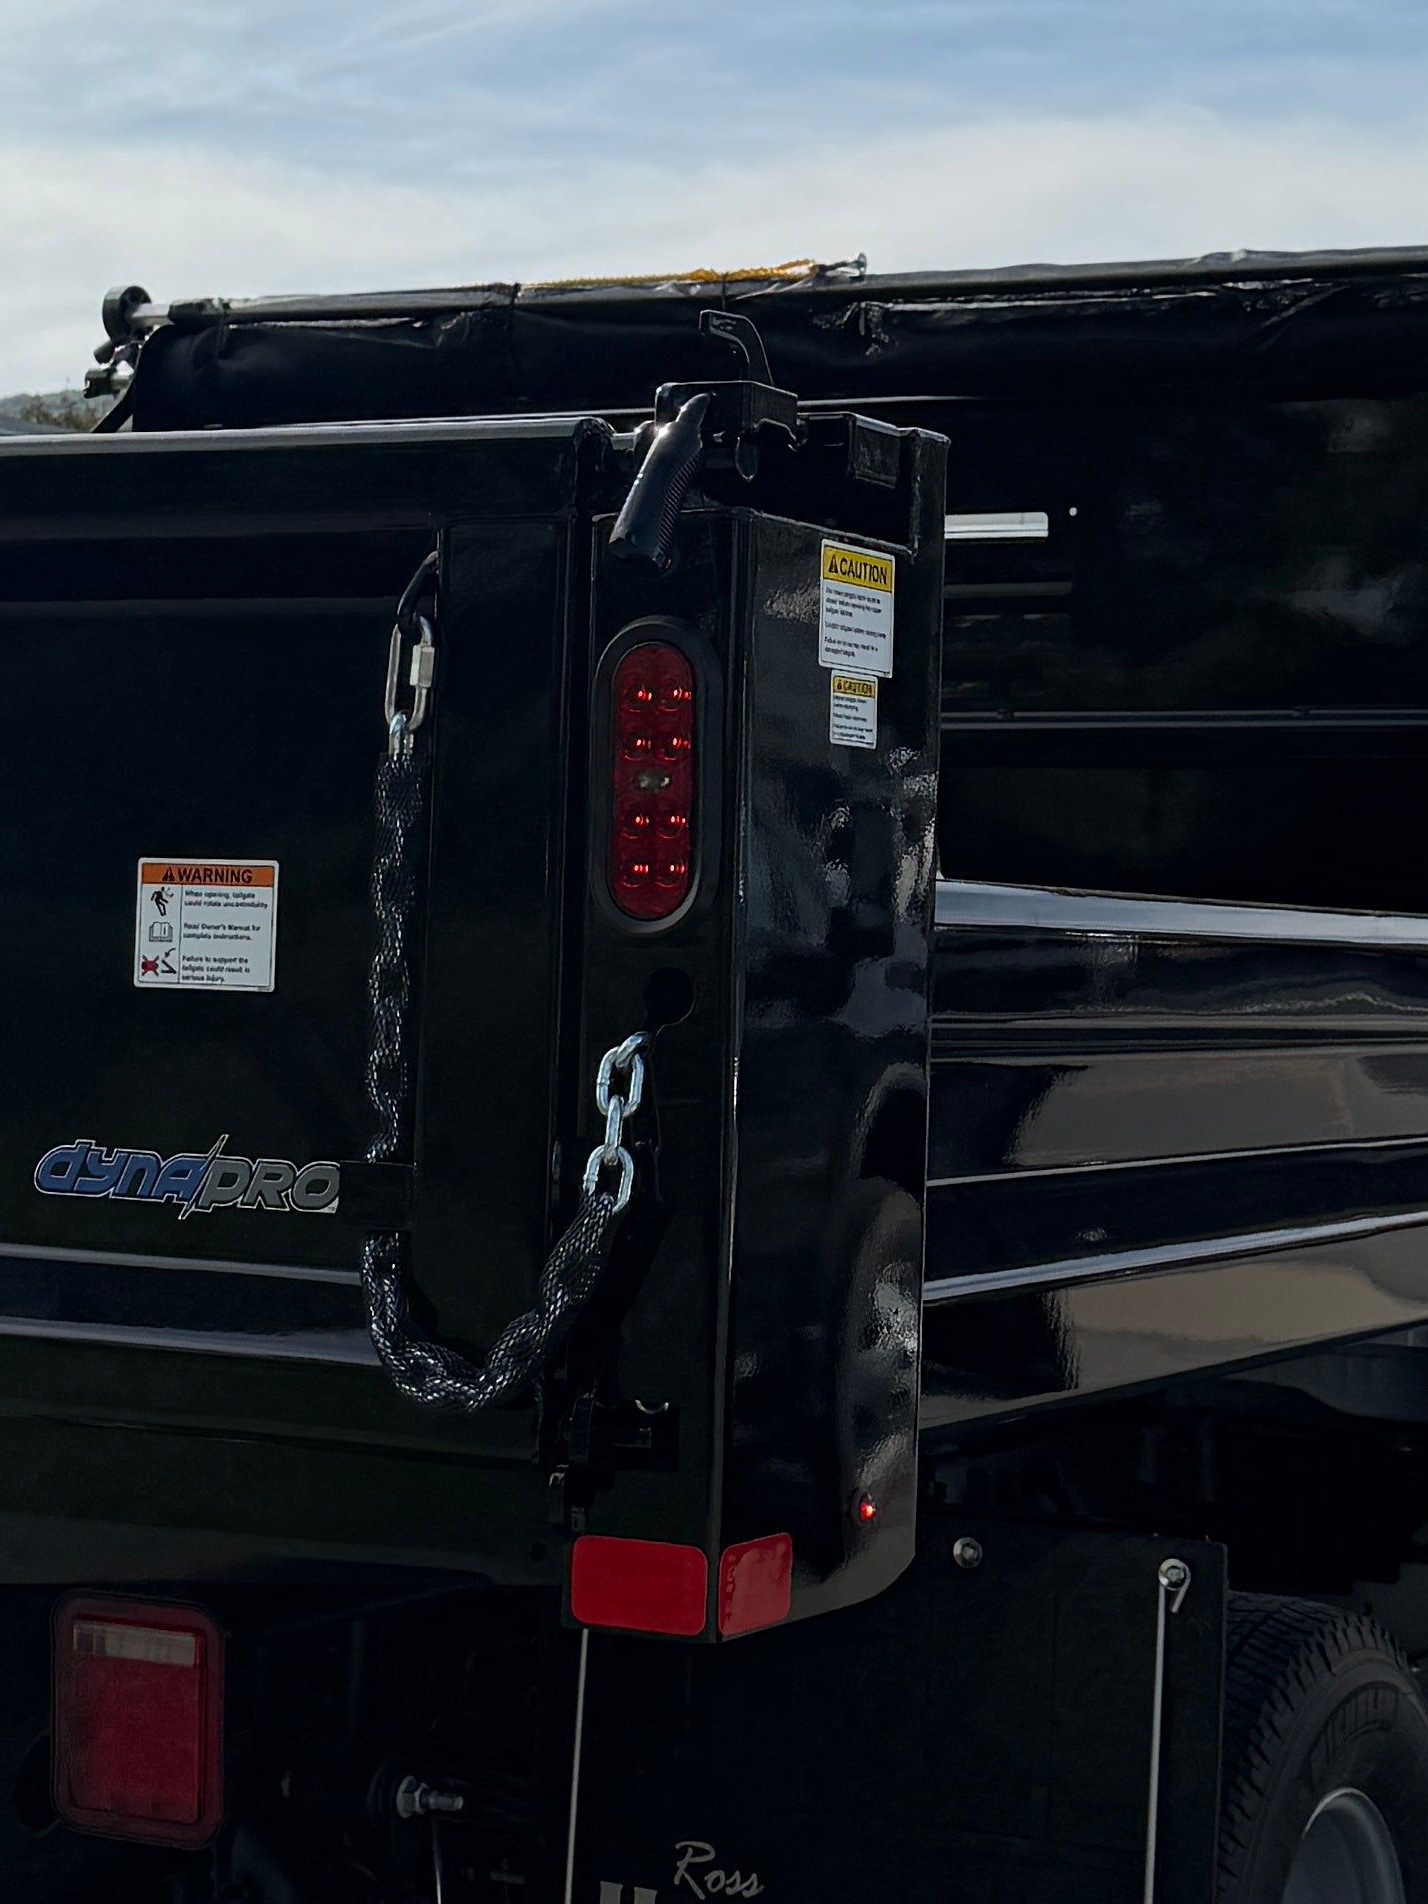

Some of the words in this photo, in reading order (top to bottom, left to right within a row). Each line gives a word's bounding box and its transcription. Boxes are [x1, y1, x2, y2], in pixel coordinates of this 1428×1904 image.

[839, 557, 888, 585] CAUTION
[177, 867, 253, 884] WARNING
[673, 1839, 765, 1901] Ross
